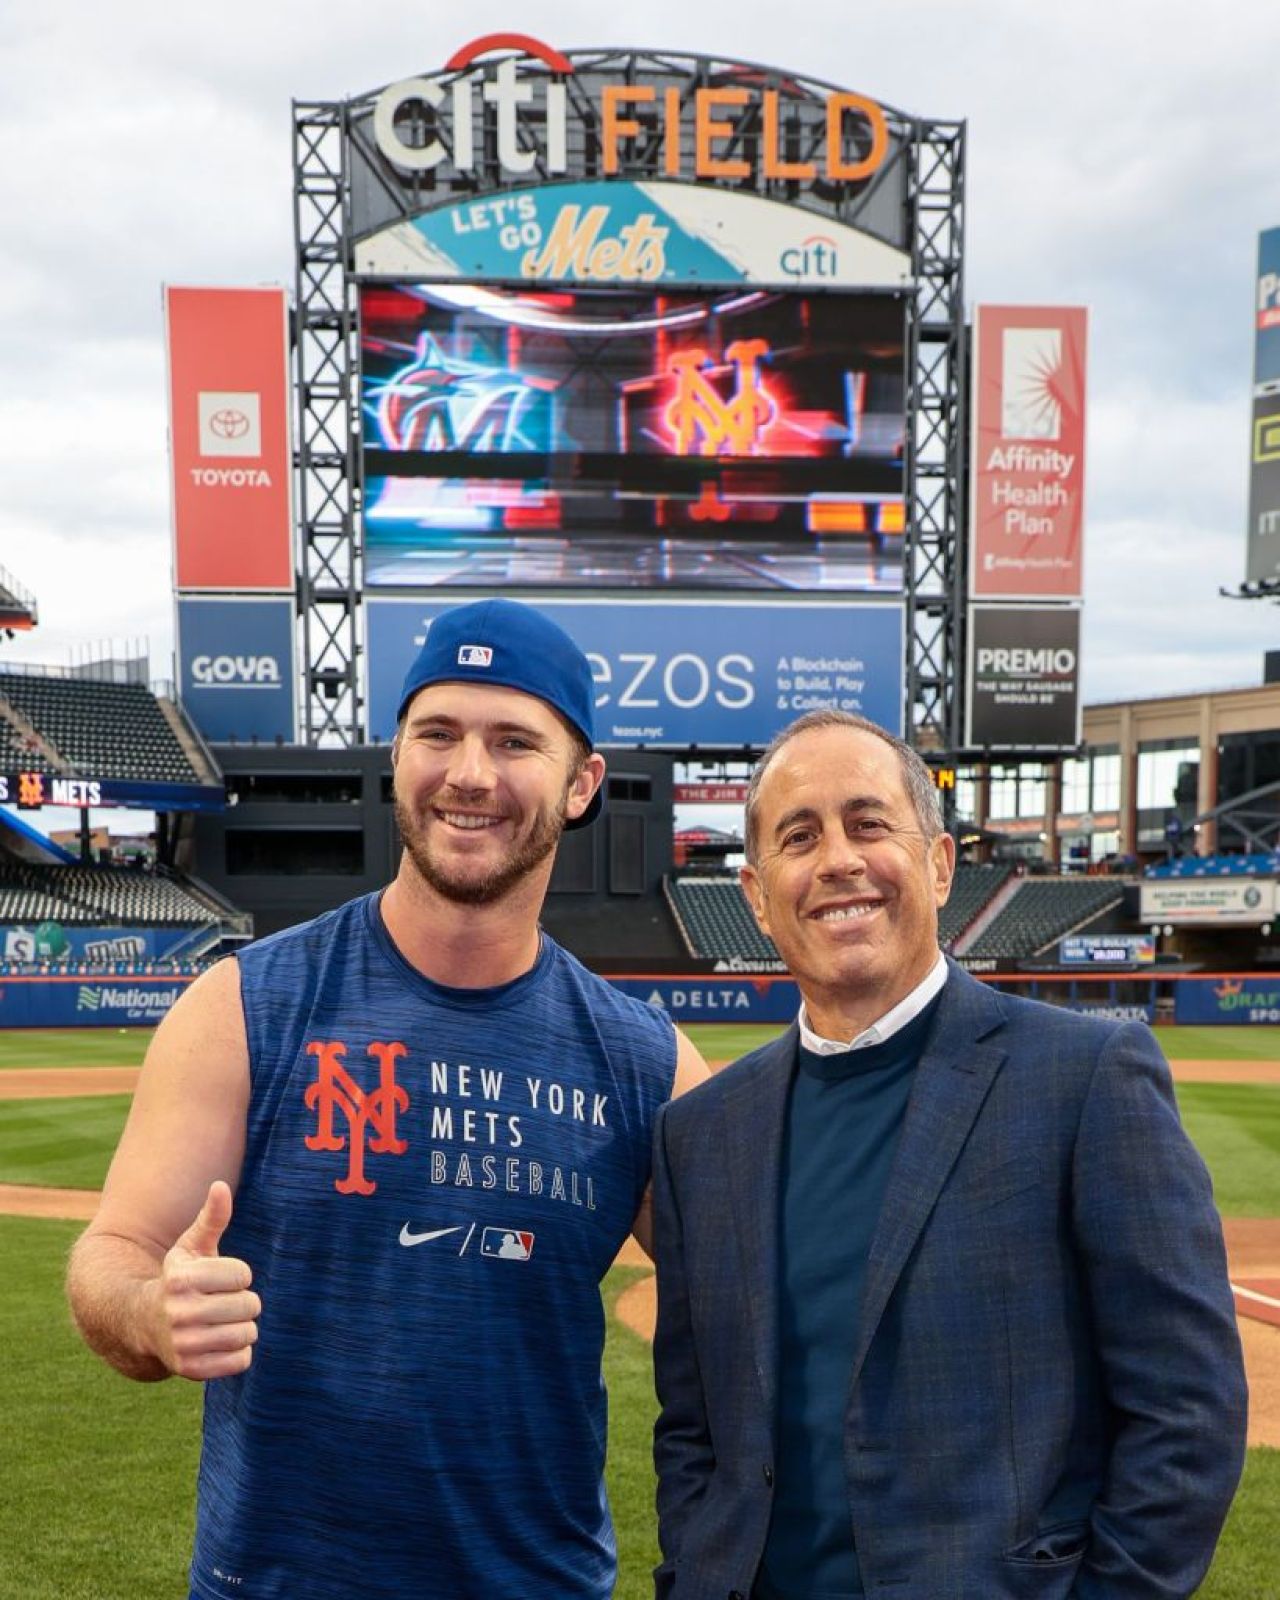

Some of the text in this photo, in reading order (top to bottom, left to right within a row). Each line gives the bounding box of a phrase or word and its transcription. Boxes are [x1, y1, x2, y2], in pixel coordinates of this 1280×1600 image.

[374, 57, 889, 180] citi FIELD
[451, 196, 537, 234] LET'S
[500, 222, 541, 250] GO
[522, 203, 669, 282] Mets
[780, 243, 838, 276] citi
[987, 446, 1075, 479] Affinity
[190, 468, 272, 487] TOYOTA
[991, 477, 1068, 507] Health
[1005, 508, 1053, 535] Plan
[191, 655, 279, 683] GOYA
[777, 656, 864, 673] A Blockchain
[976, 648, 1076, 674] PREMIO
[586, 652, 756, 709] ezos
[777, 676, 792, 690] to
[835, 676, 865, 693] Play
[777, 695, 788, 710] &
[791, 695, 838, 711] Collect
[52, 779, 101, 806] METS
[680, 788, 709, 800] THE
[101, 987, 178, 1009] National
[672, 990, 750, 1008] DELTA
[1218, 992, 1280, 1011] DRAF
[1249, 1008, 1280, 1022] SPO
[430, 1061, 608, 1127] NEW YORK
[303, 1041, 411, 1195] NY
[430, 1106, 523, 1148] METS
[430, 1150, 597, 1210] BASEBALL
